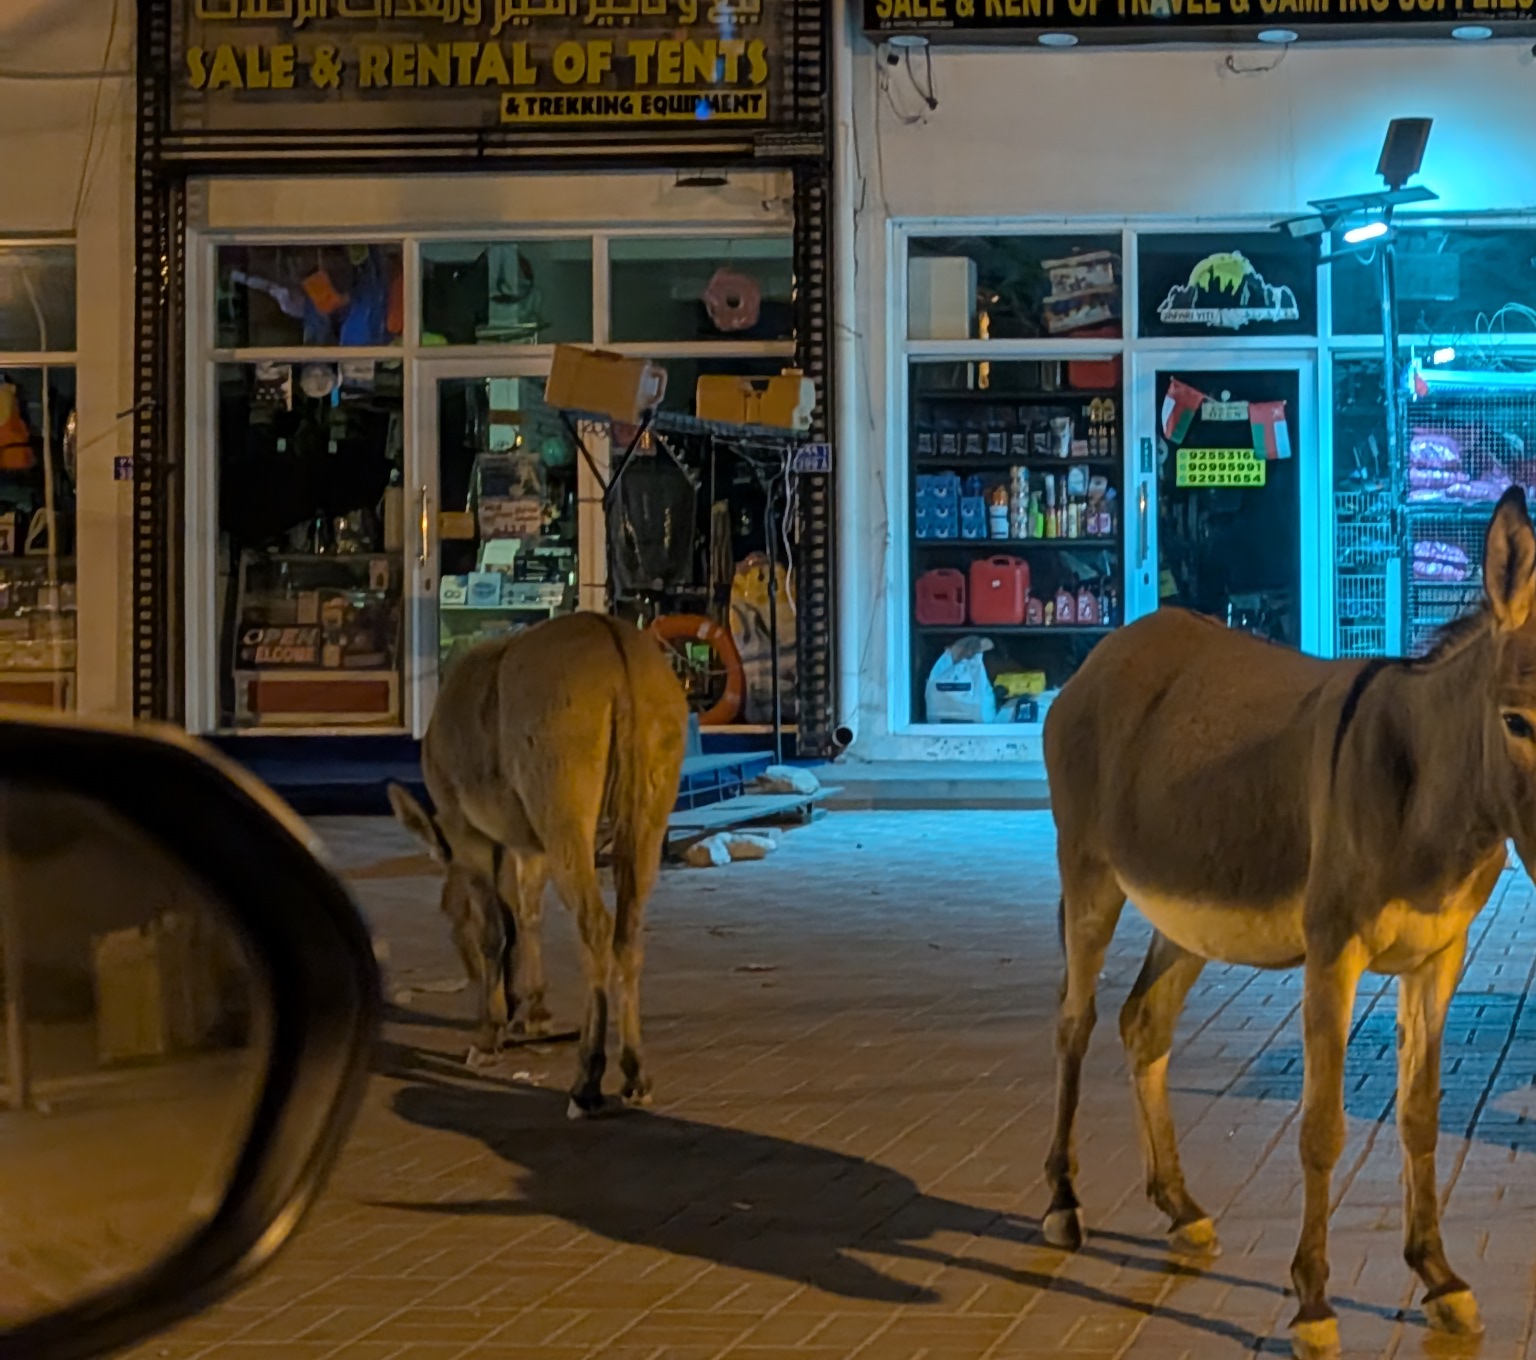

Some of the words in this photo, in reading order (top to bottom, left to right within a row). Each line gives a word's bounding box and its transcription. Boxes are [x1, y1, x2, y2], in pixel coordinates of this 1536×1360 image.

[187, 43, 297, 90] SALE
[310, 43, 342, 89] &
[360, 41, 538, 88] RENTAL
[552, 41, 616, 85] OF
[627, 38, 769, 85] TENTS
[505, 98, 521, 116] &
[526, 96, 634, 116] TREKKING
[640, 93, 764, 115] EQUIPMENT
[1189, 451, 1255, 460] 9255316
[1189, 462, 1261, 472] 90995991
[1189, 474, 1261, 483] 92931654
